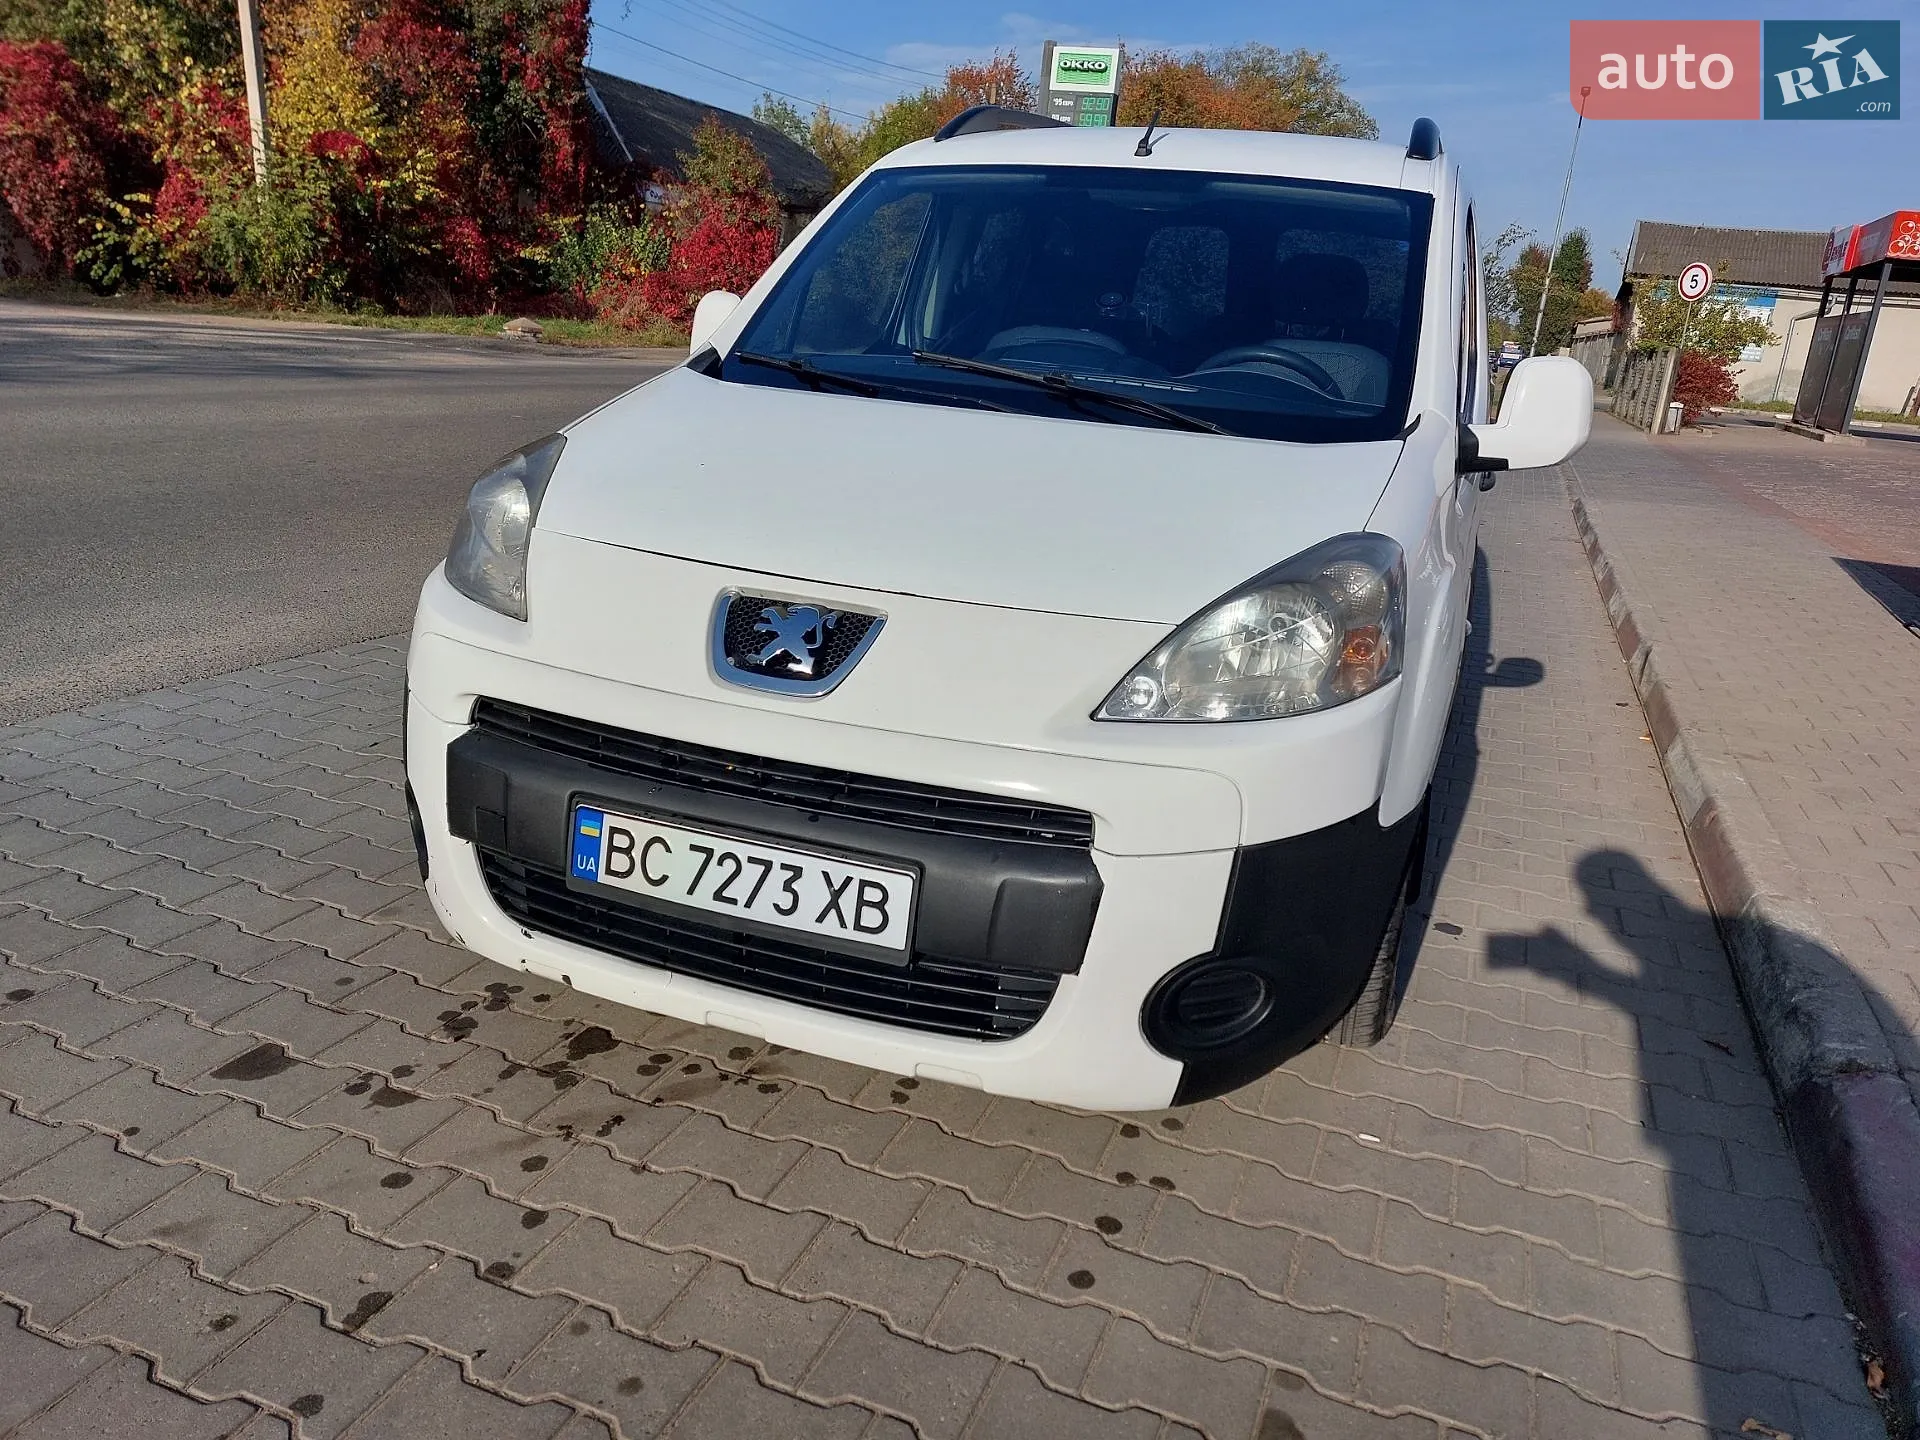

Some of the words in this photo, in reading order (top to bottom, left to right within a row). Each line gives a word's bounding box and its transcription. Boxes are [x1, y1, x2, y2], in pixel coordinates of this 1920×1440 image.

[1060, 59, 1107, 72] OKKO
[1690, 274, 1699, 289] 5
[577, 854, 596, 873] UA
[605, 826, 672, 887] BC
[686, 844, 804, 917] 7273
[815, 870, 890, 935] XB
